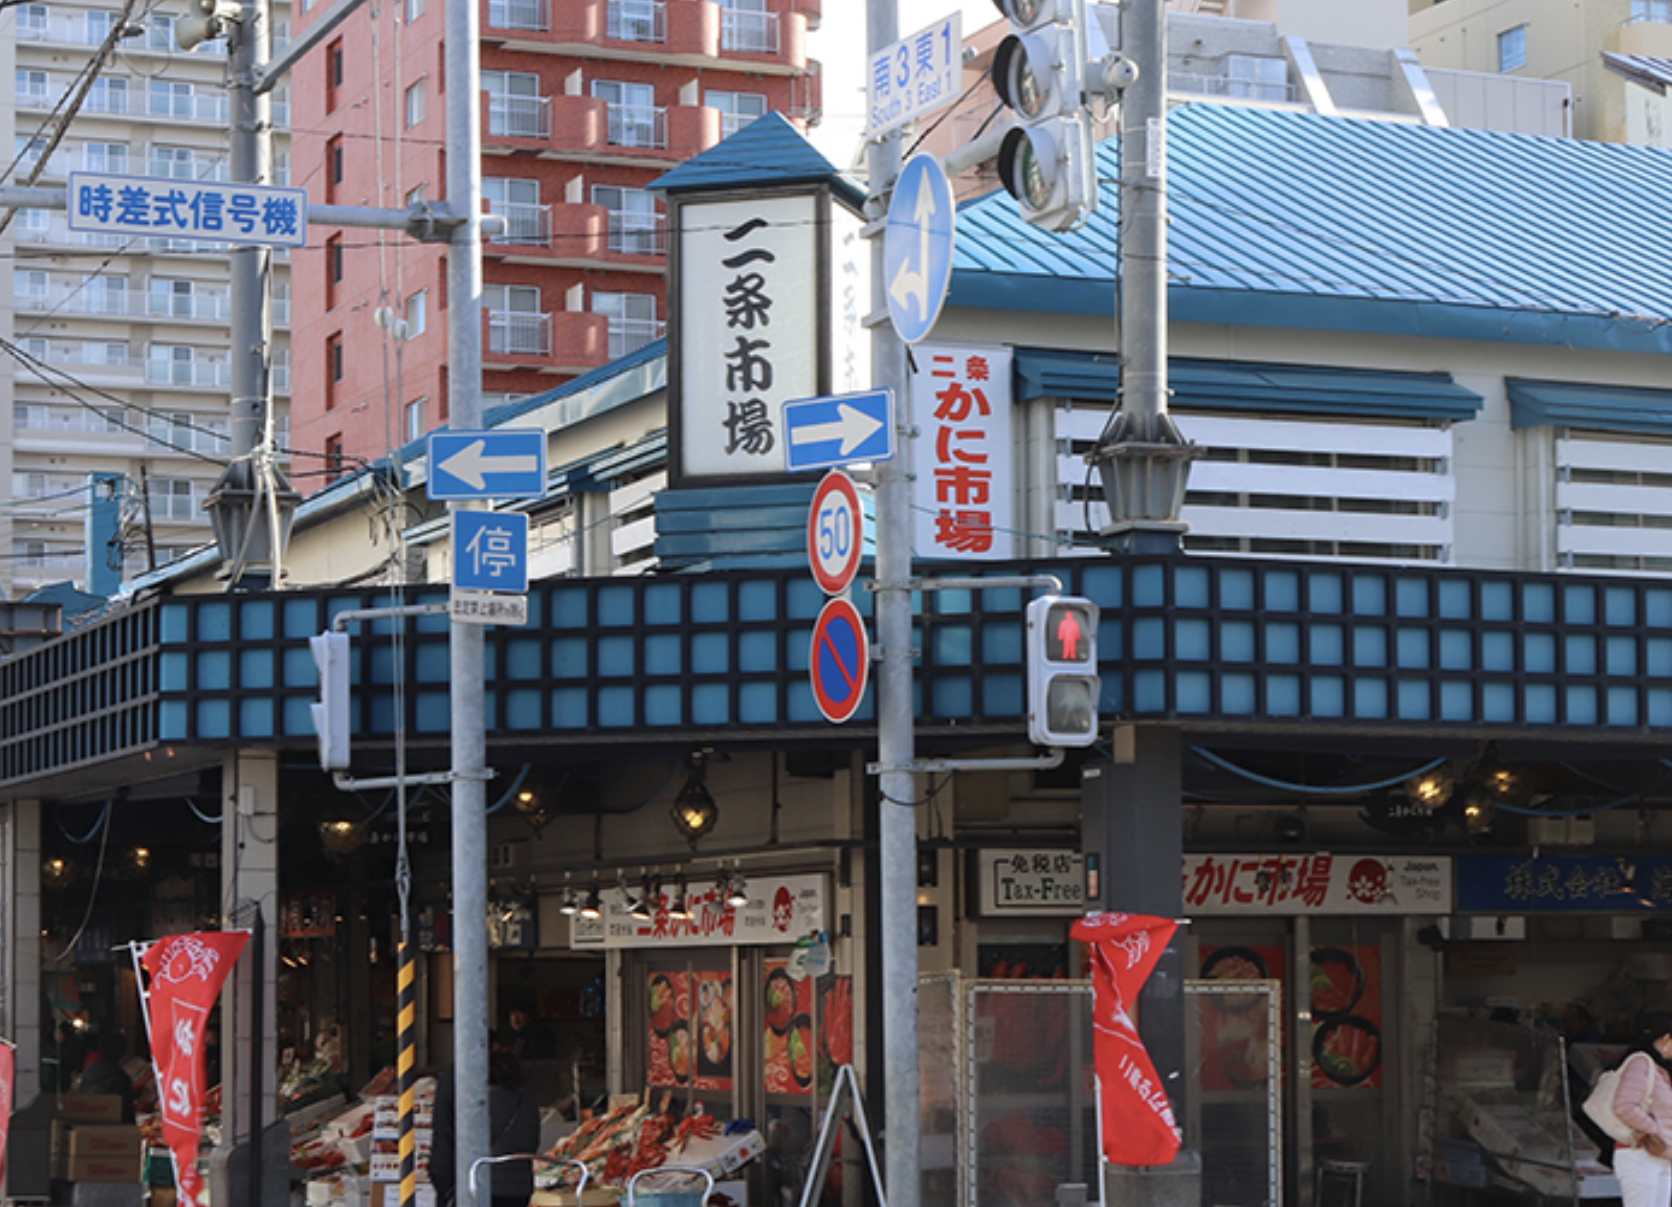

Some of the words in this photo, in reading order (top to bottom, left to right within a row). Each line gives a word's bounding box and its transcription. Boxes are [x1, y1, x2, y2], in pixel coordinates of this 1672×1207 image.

[872, 97, 901, 128] South
[905, 88, 912, 111] 3
[918, 75, 941, 105] East
[945, 69, 951, 91] 1
[79, 183, 298, 236] 時差式信号機
[721, 217, 776, 456] 二条市場
[933, 382, 993, 553] かに市場
[465, 525, 517, 577] 停
[820, 506, 850, 560] 50
[1001, 877, 1082, 901] Tax-Free
[1011, 853, 1071, 873] 免税店
[1182, 855, 1333, 907] かに市場
[1504, 863, 1629, 900] 株式会社
